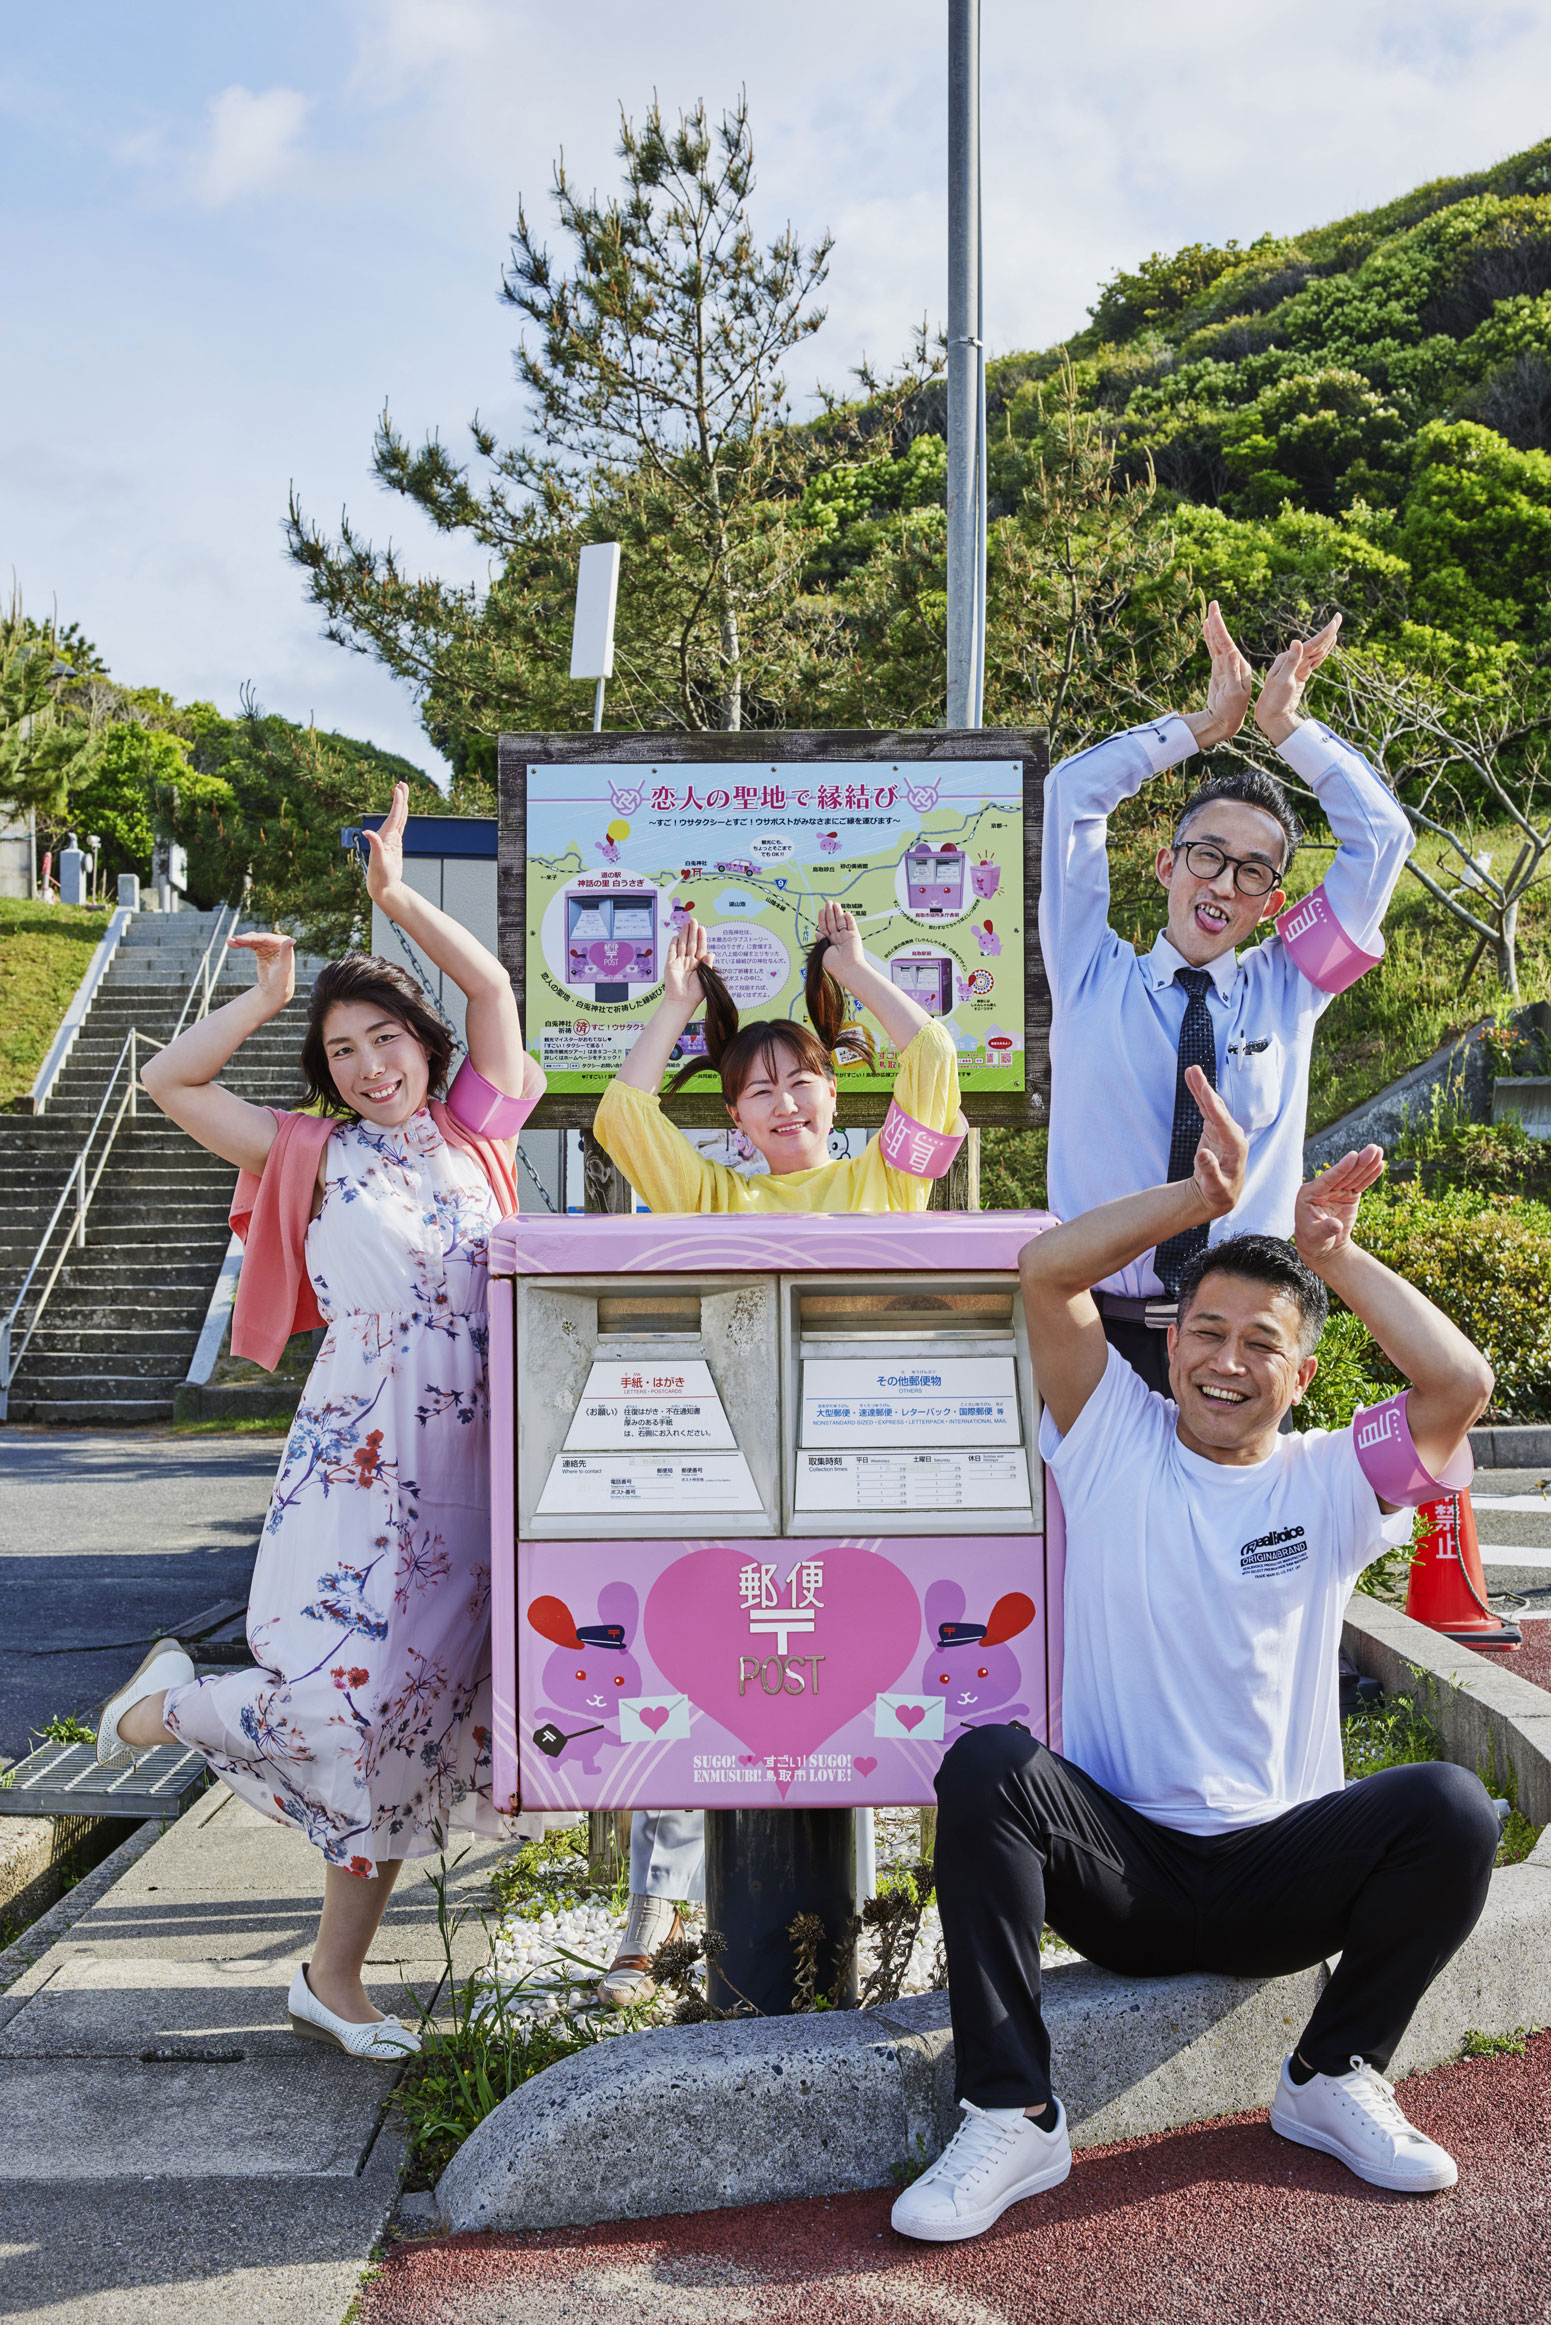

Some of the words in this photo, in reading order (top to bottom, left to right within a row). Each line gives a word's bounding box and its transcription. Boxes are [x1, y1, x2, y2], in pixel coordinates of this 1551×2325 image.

[650, 784, 900, 811] 恋人の聖地で縁結び
[600, 871, 622, 879] 道の駅
[577, 879, 610, 888] 神話の里
[612, 879, 645, 888] 白うさぎ
[604, 958, 618, 966] POST
[575, 1021, 588, 1034] 済
[882, 1108, 945, 1174] 鳥取
[620, 1376, 685, 1389] 手紙・はがき
[876, 1375, 942, 1387] その他郵便物
[623, 1407, 701, 1416] 往復はがき・不在通知書
[623, 1418, 674, 1427] 厚みのある手紙
[623, 1429, 712, 1438] は、右側にお入れください。
[562, 1459, 587, 1468] 連絡先
[808, 1457, 843, 1466] 取集時刻
[739, 1560, 825, 1609] 郵便
[739, 1655, 825, 1696] POST
[693, 1754, 736, 1768] SUGO!
[809, 1754, 852, 1768] SUGO!
[693, 1769, 762, 1783] ENMUSUBI!
[763, 1769, 807, 1782] 鳥取市
[809, 1768, 852, 1783] LOVE!
